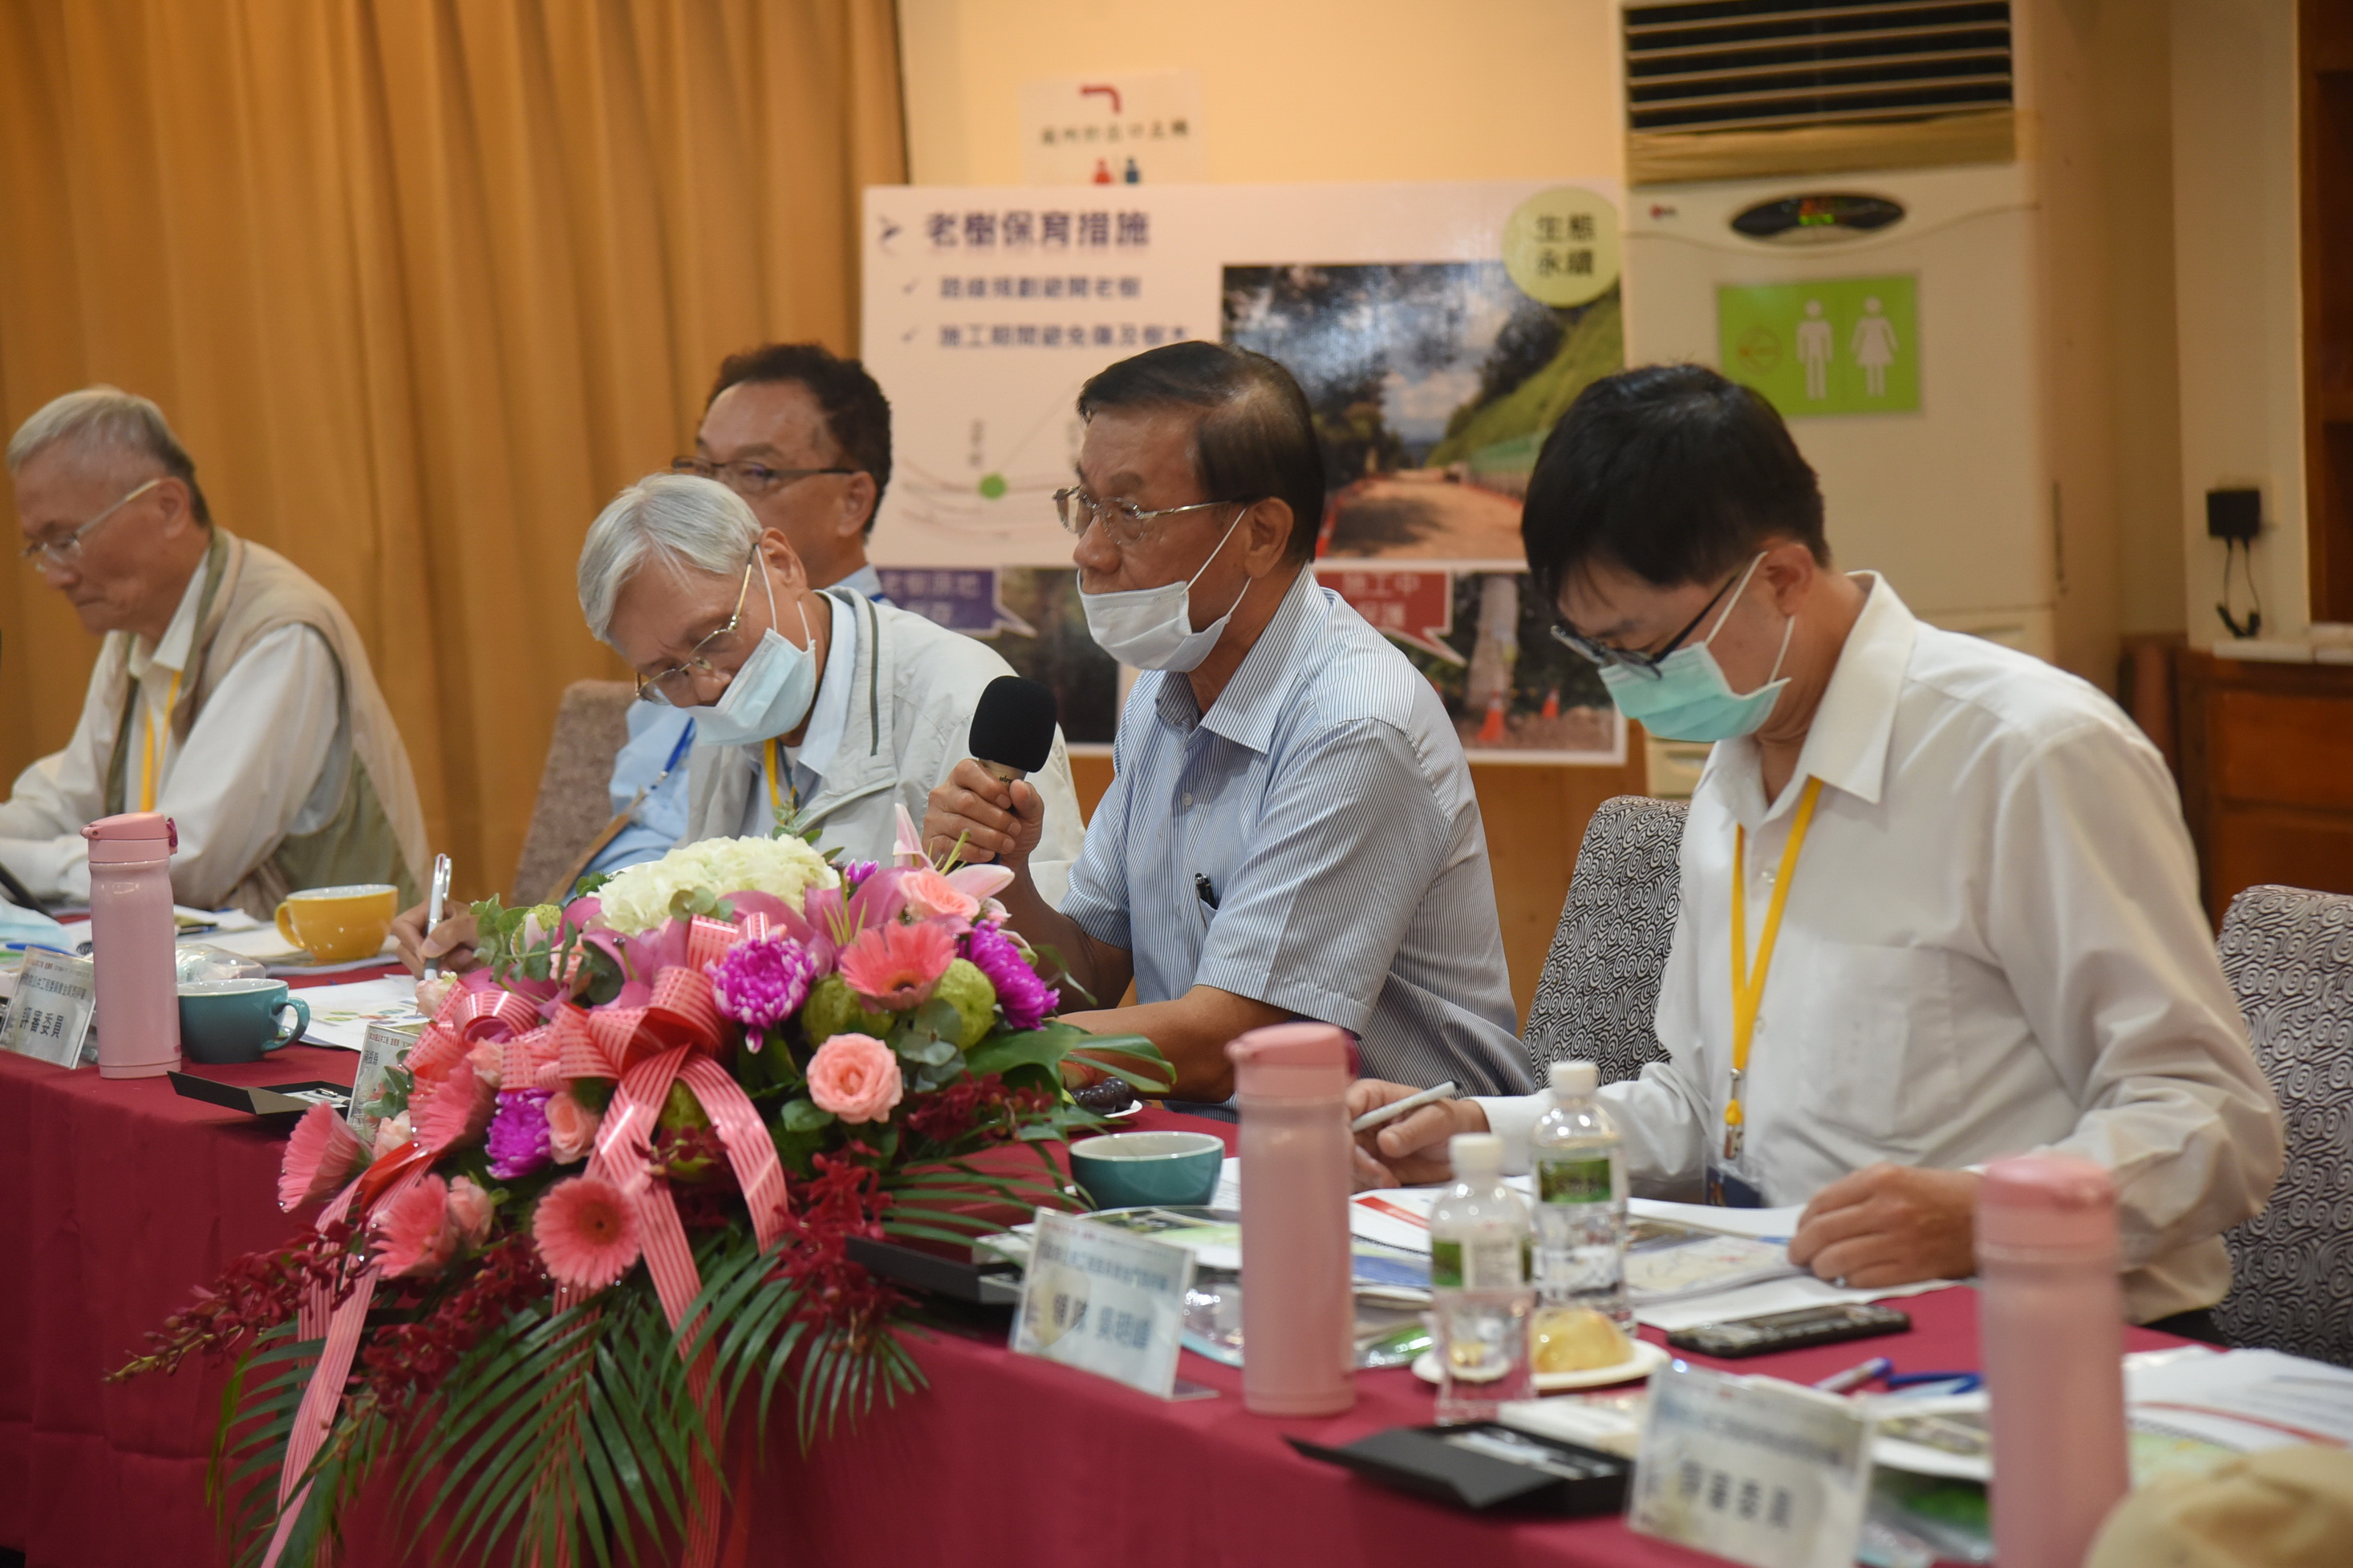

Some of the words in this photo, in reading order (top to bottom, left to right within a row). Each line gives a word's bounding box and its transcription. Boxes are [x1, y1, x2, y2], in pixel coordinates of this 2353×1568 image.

[928, 210, 1150, 246] 老樹保育措施
[1536, 213, 1595, 244] 生態
